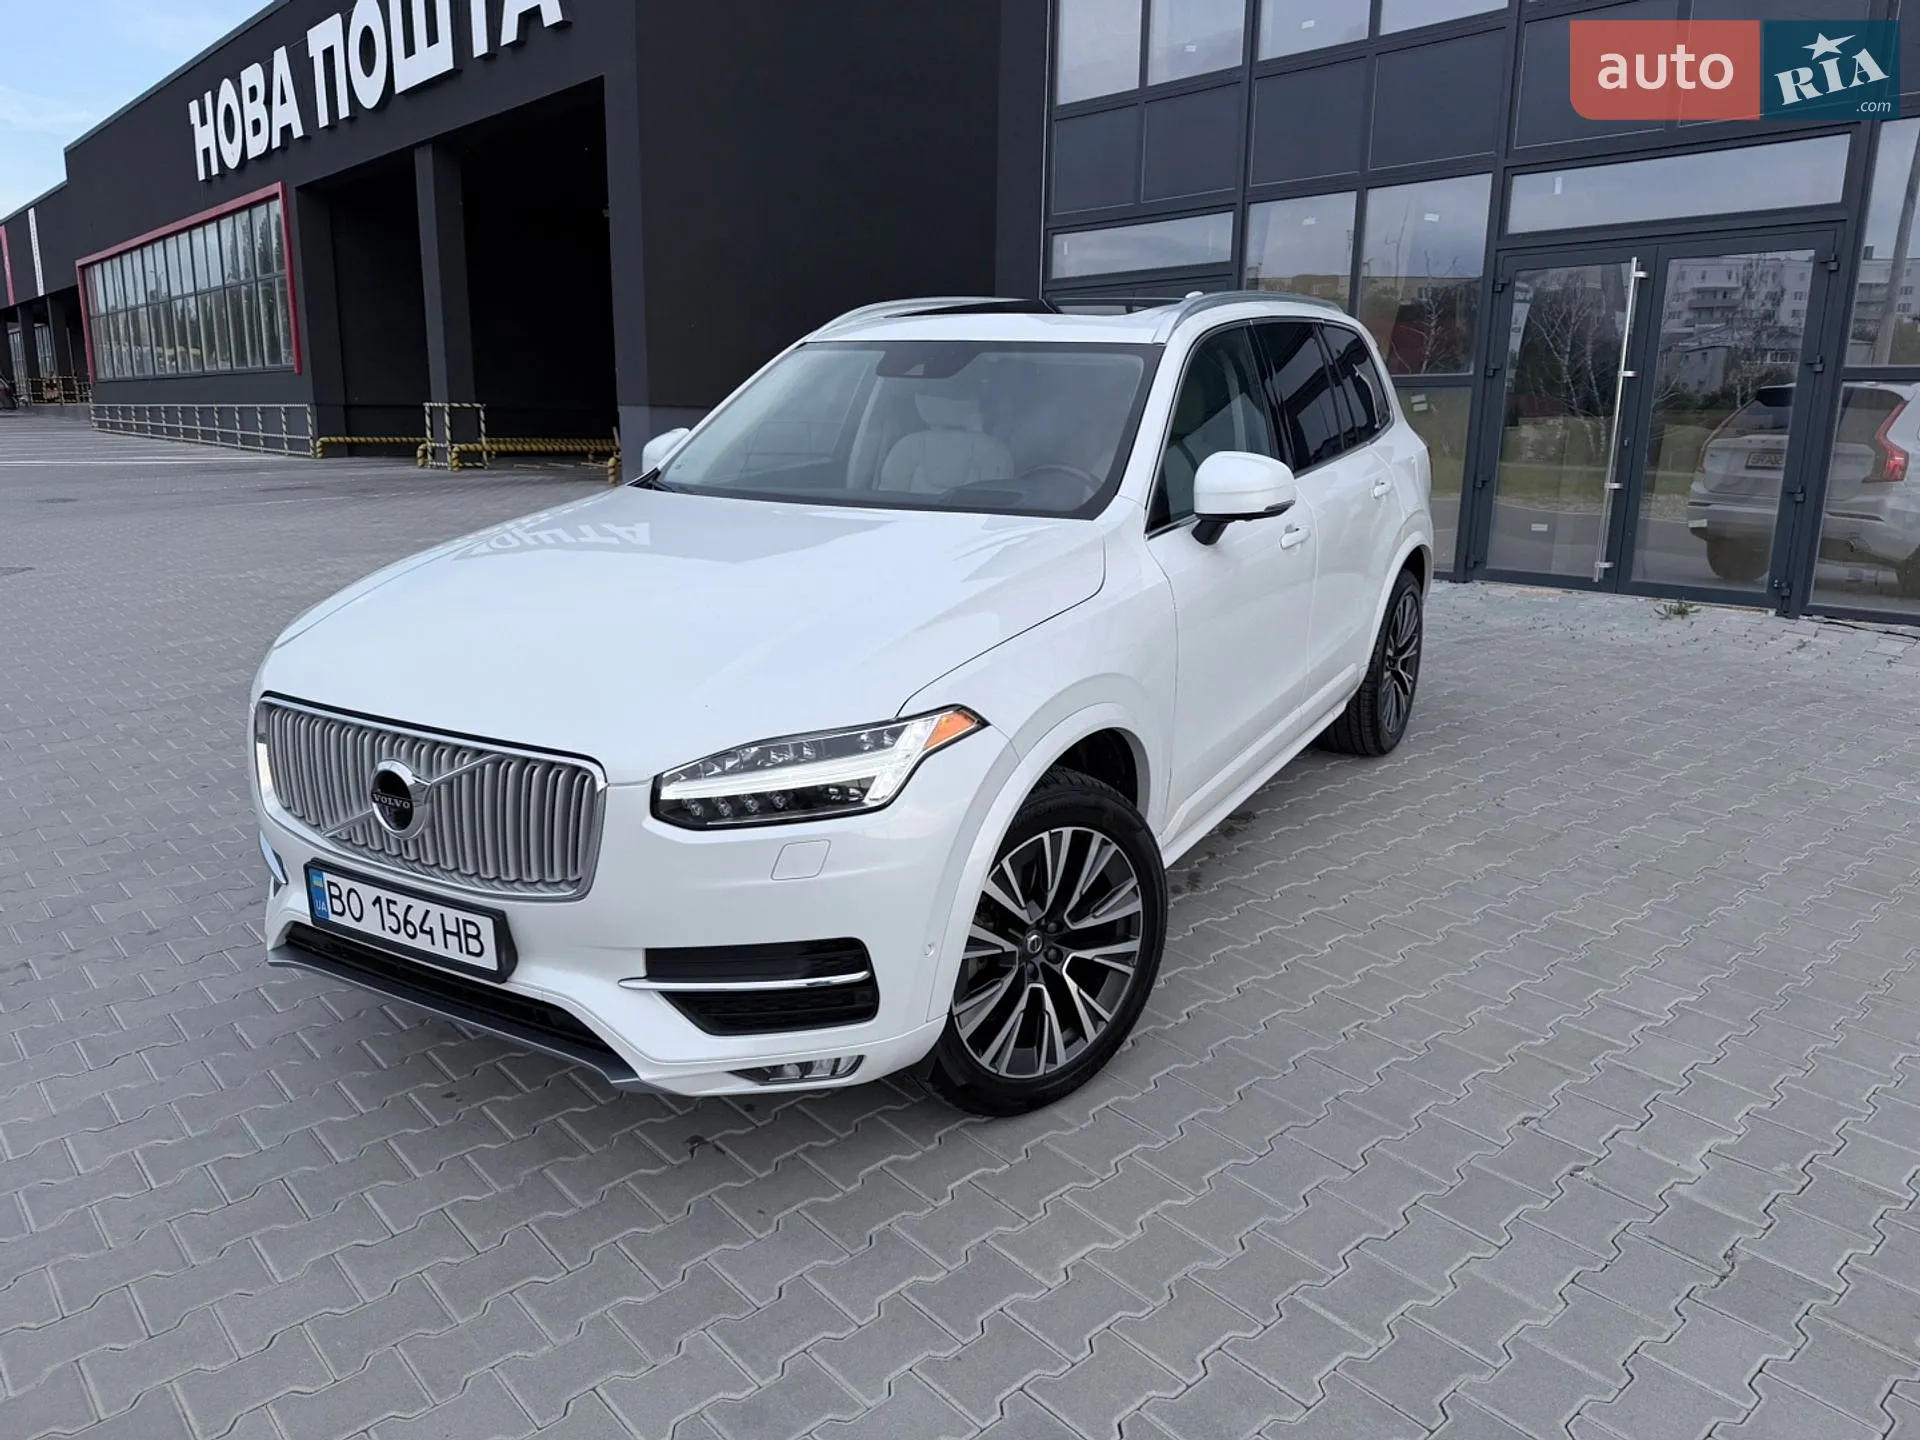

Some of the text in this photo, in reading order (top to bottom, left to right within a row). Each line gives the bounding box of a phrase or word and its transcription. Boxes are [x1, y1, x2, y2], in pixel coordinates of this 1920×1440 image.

[188, 0, 563, 181] НОВА ПОШ
[372, 793, 411, 809] VOLVO
[315, 901, 328, 912] UA
[327, 880, 485, 958] BO 1564 HB
